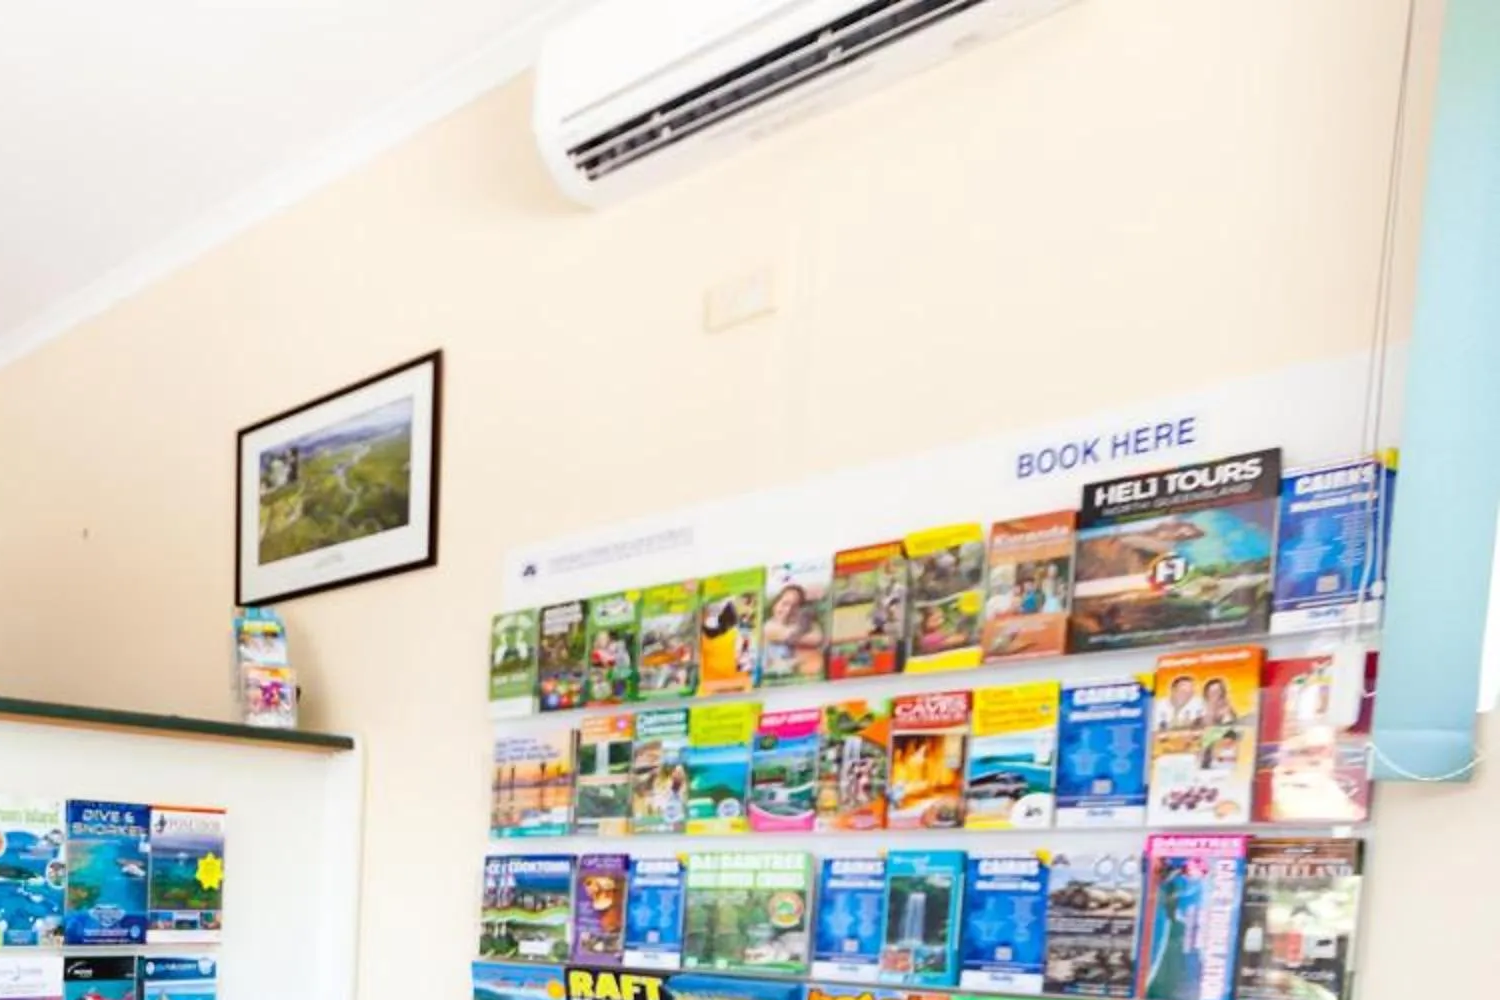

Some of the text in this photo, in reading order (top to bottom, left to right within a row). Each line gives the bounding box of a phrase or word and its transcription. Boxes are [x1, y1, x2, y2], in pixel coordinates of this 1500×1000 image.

[1017, 417, 1196, 478] BOOK HERE
[1094, 458, 1263, 507] HELI TOURS
[82, 810, 121, 823] DIVE
